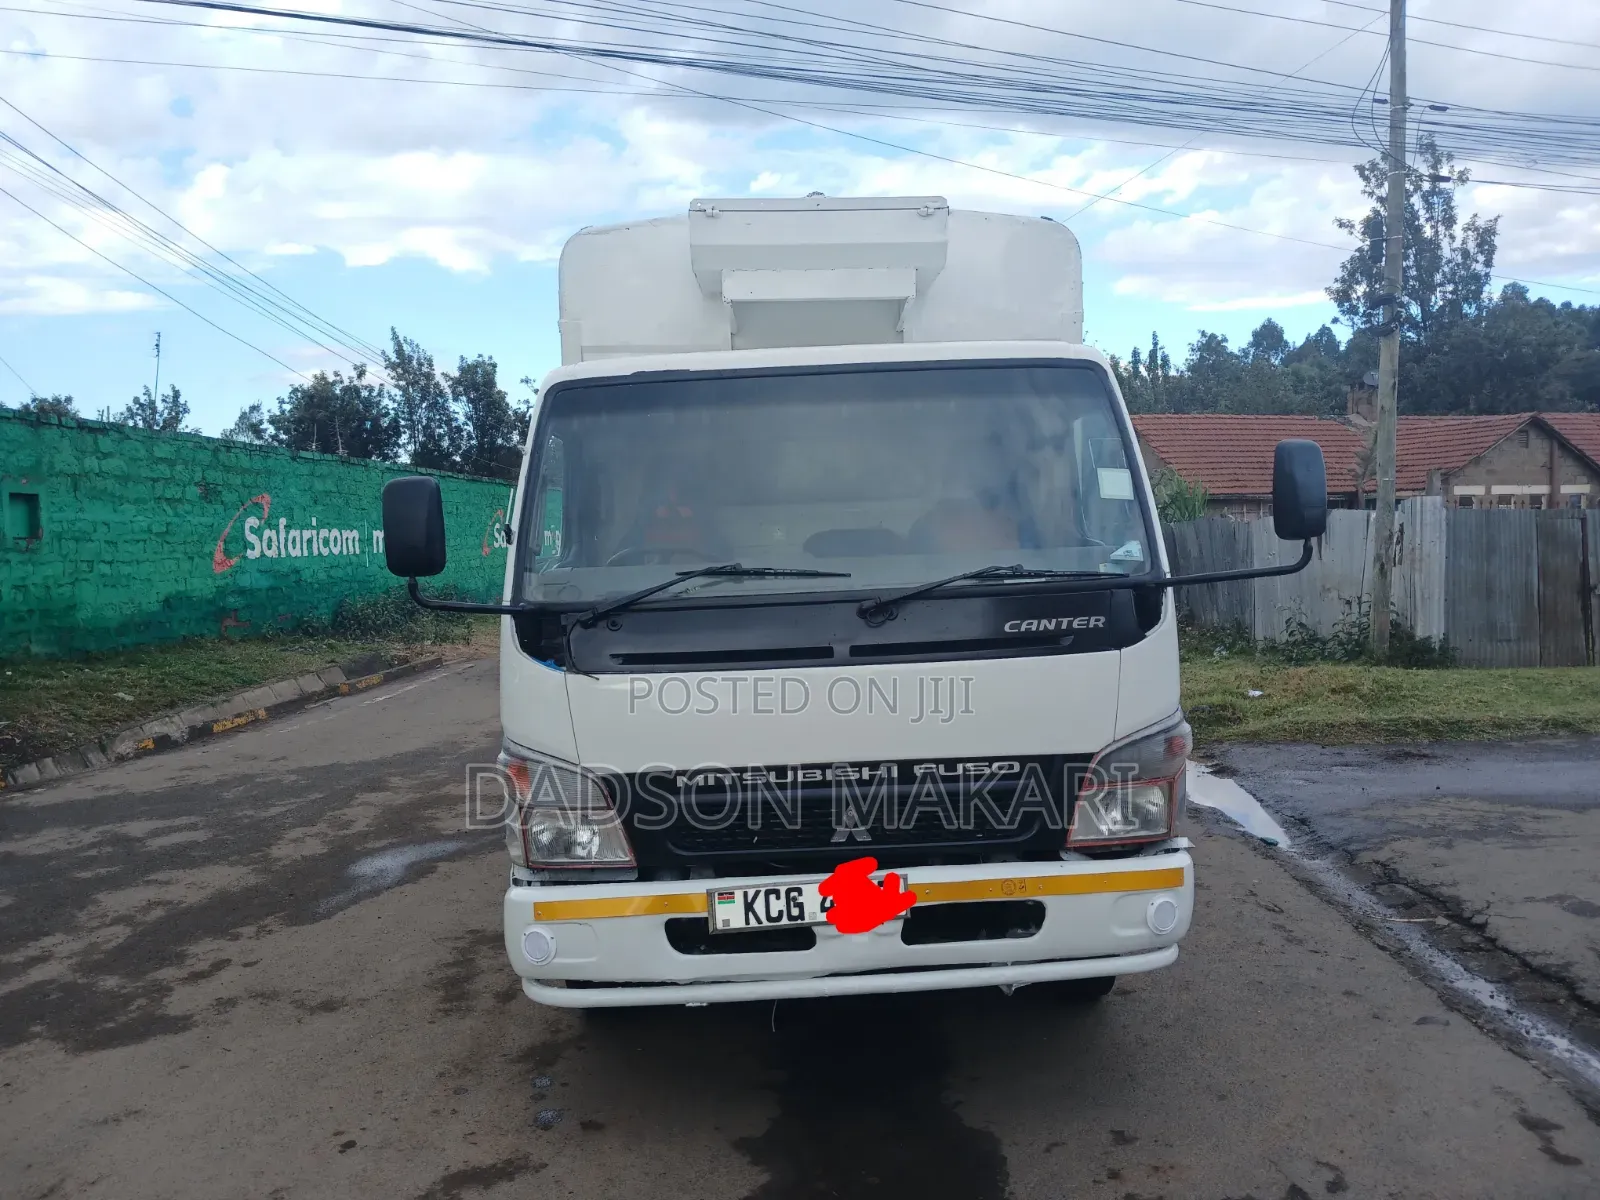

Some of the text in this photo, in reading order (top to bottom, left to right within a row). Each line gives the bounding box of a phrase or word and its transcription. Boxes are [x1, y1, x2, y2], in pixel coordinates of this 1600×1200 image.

[244, 516, 360, 559] Safaricom
[1003, 615, 1106, 632] CANTER
[676, 760, 1021, 787] MITSUBISHI FUSO
[743, 886, 806, 926] KCG
